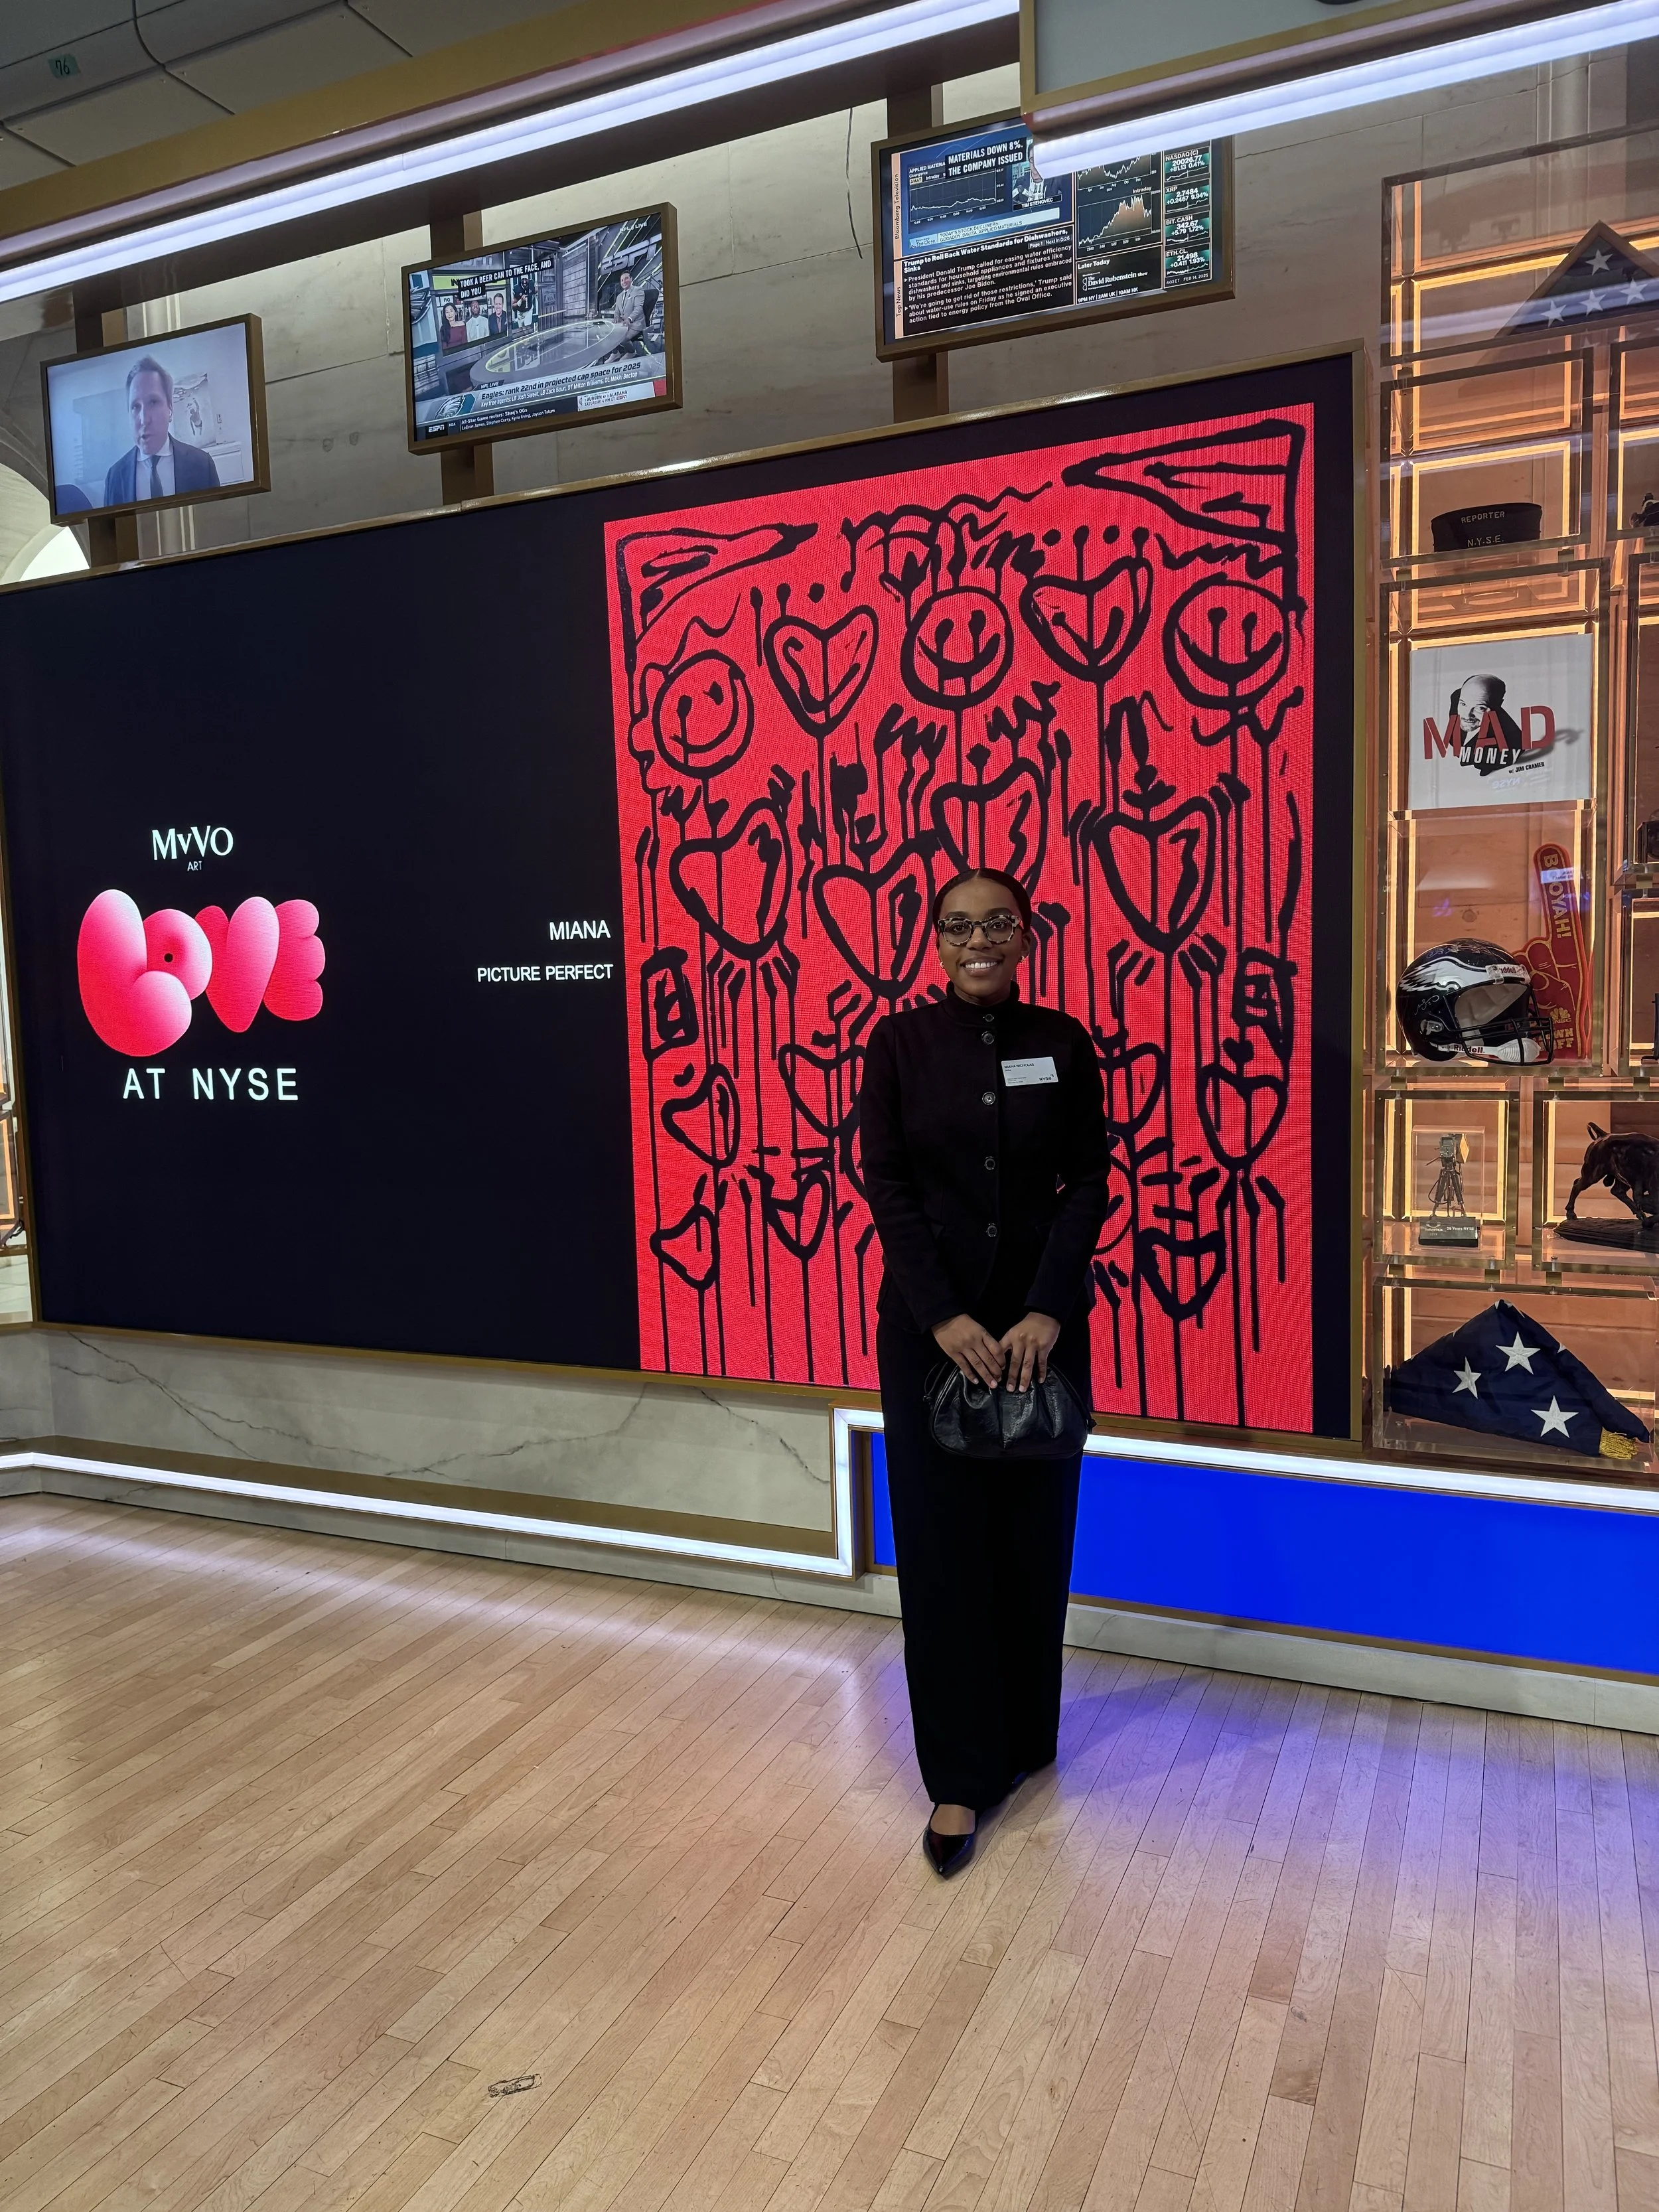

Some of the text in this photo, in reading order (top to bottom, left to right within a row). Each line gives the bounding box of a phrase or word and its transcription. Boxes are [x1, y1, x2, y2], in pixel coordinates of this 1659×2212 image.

[55, 58, 70, 76] 76
[948, 139, 1023, 164] MATERIALS DOWN 8%.
[948, 151, 1023, 176] THE COMPANY ISSUED
[904, 258, 924, 267] Trump
[961, 246, 979, 255] Water
[981, 240, 1013, 251] Standards
[1024, 229, 1068, 242] Dishwashers,
[461, 278, 474, 287] TOOK
[480, 273, 492, 283] BEER
[494, 271, 504, 279] CAN
[514, 266, 523, 275] THE
[525, 262, 539, 273] FACE,
[541, 259, 551, 268] AND
[908, 272, 934, 281] President
[936, 267, 955, 276] Donald
[957, 263, 975, 273] Trump
[977, 259, 993, 268] called
[1005, 254, 1023, 263] easing
[1043, 244, 1072, 255] efficiency
[908, 278, 936, 288] standards
[949, 269, 979, 280] household
[981, 263, 1012, 275] appliances
[1027, 255, 1050, 264] fixtures
[1093, 258, 1110, 267] Today
[908, 284, 939, 295] dishwashers
[968, 274, 991, 283] targeting
[993, 266, 1029, 277] environmental
[1045, 257, 1072, 267] embraced
[1088, 277, 1104, 286] David
[1105, 271, 1137, 283] Rubenstein
[461, 287, 481, 298] DID YOU
[926, 303, 953, 313] water-use
[1015, 287, 1033, 297] signed
[1044, 280, 1072, 290] executive
[927, 285, 963, 298] predecessor
[928, 299, 944, 307] going
[1039, 276, 1058, 285] Trump
[949, 307, 968, 316] energy
[970, 303, 987, 312] policy
[1032, 291, 1052, 299] Office.
[482, 390, 504, 400] Eagles:
[520, 383, 536, 392] 22nd
[545, 375, 577, 388] projected
[591, 370, 610, 378] space
[1461, 511, 1505, 523] REPORTER
[1423, 705, 1555, 759] MAD
[1460, 746, 1522, 765] MONEY
[1526, 762, 1545, 771] CRAMER
[187, 861, 202, 871] ART
[549, 920, 611, 940] MIANA
[77, 889, 326, 1057] LOVE
[477, 964, 614, 982] PICTURE PERFECT
[123, 1068, 299, 1100] AT NYSE
